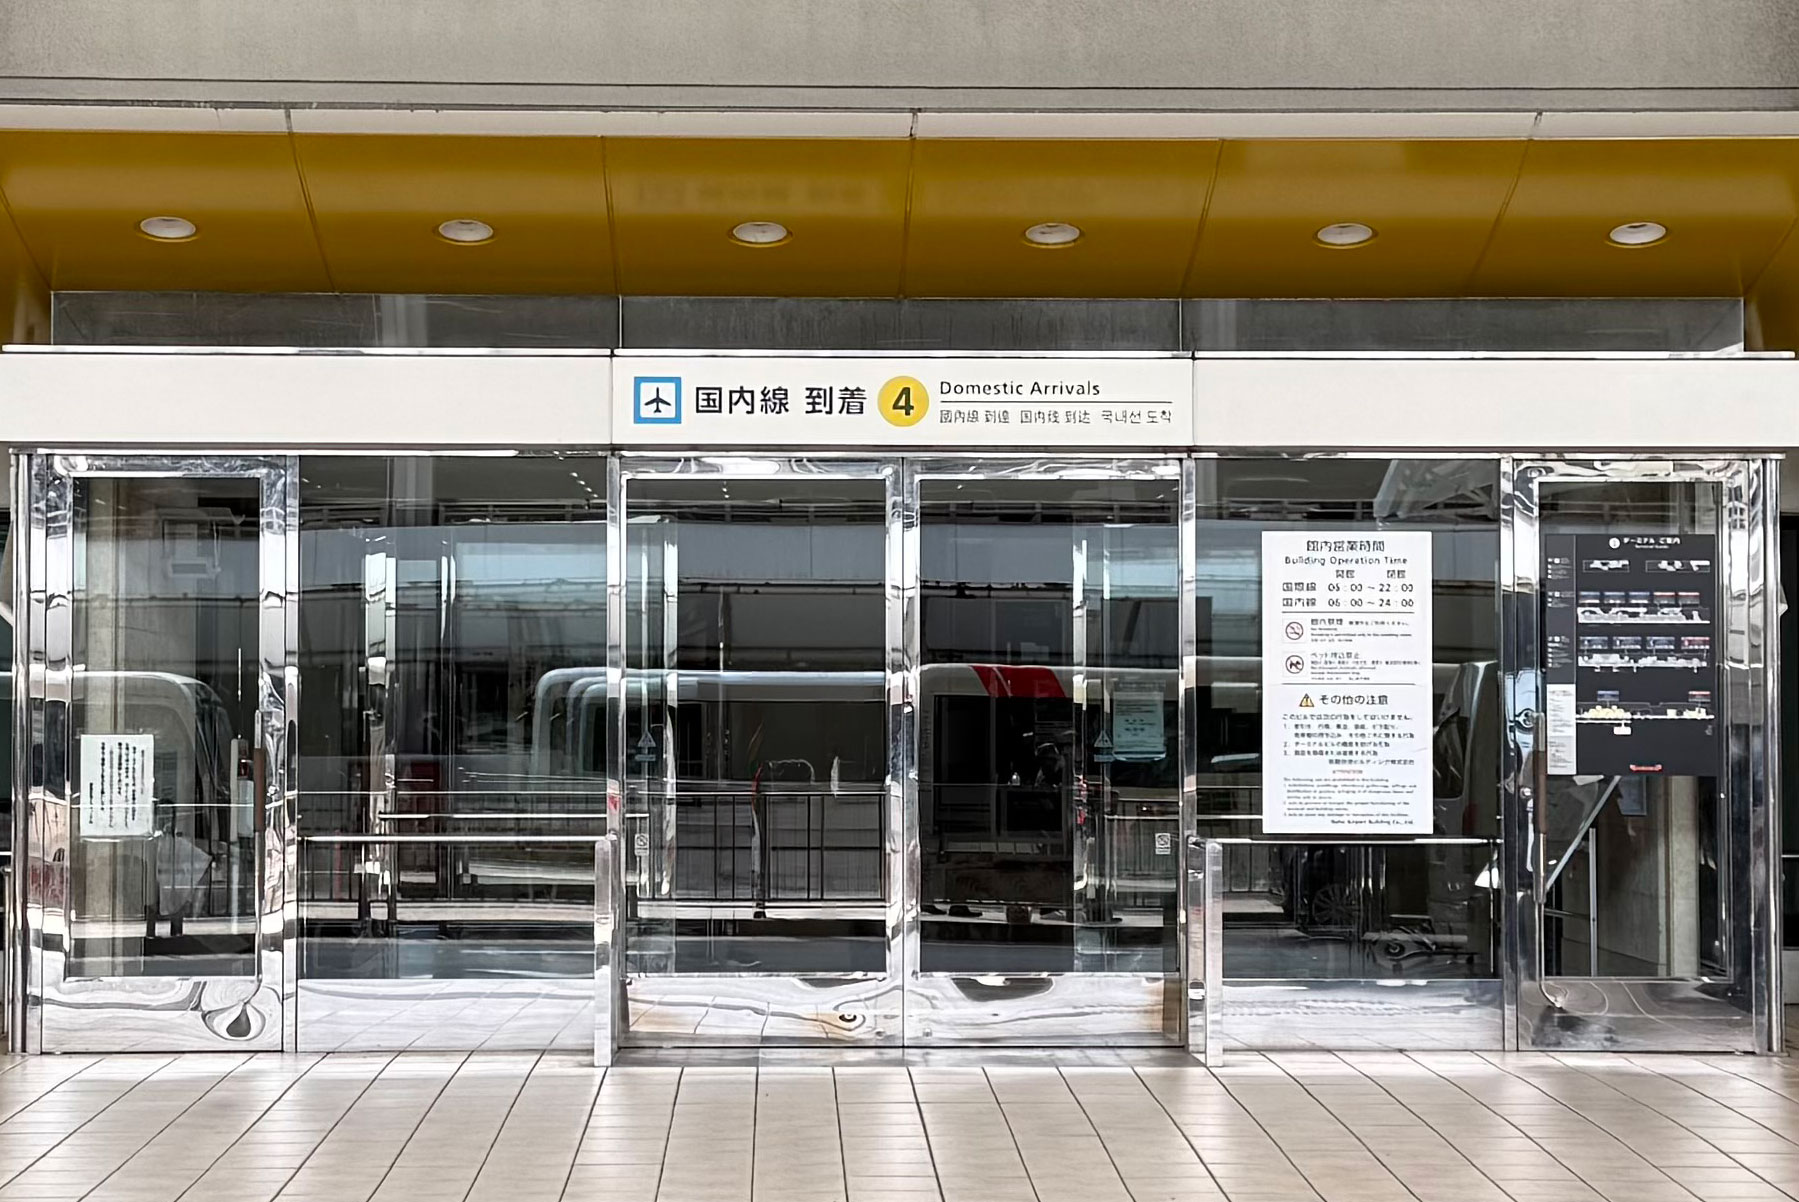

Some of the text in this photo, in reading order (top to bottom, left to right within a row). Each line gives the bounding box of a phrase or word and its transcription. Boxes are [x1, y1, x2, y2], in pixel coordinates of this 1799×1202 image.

[940, 381, 1100, 396] Domestic Arrivals
[695, 385, 915, 417] 国内線 到着 4
[1101, 409, 1141, 424] 국내선
[1146, 409, 1172, 424] 도착
[1284, 556, 1408, 567] Building Operation Time
[1319, 694, 1388, 706] その他の注意
